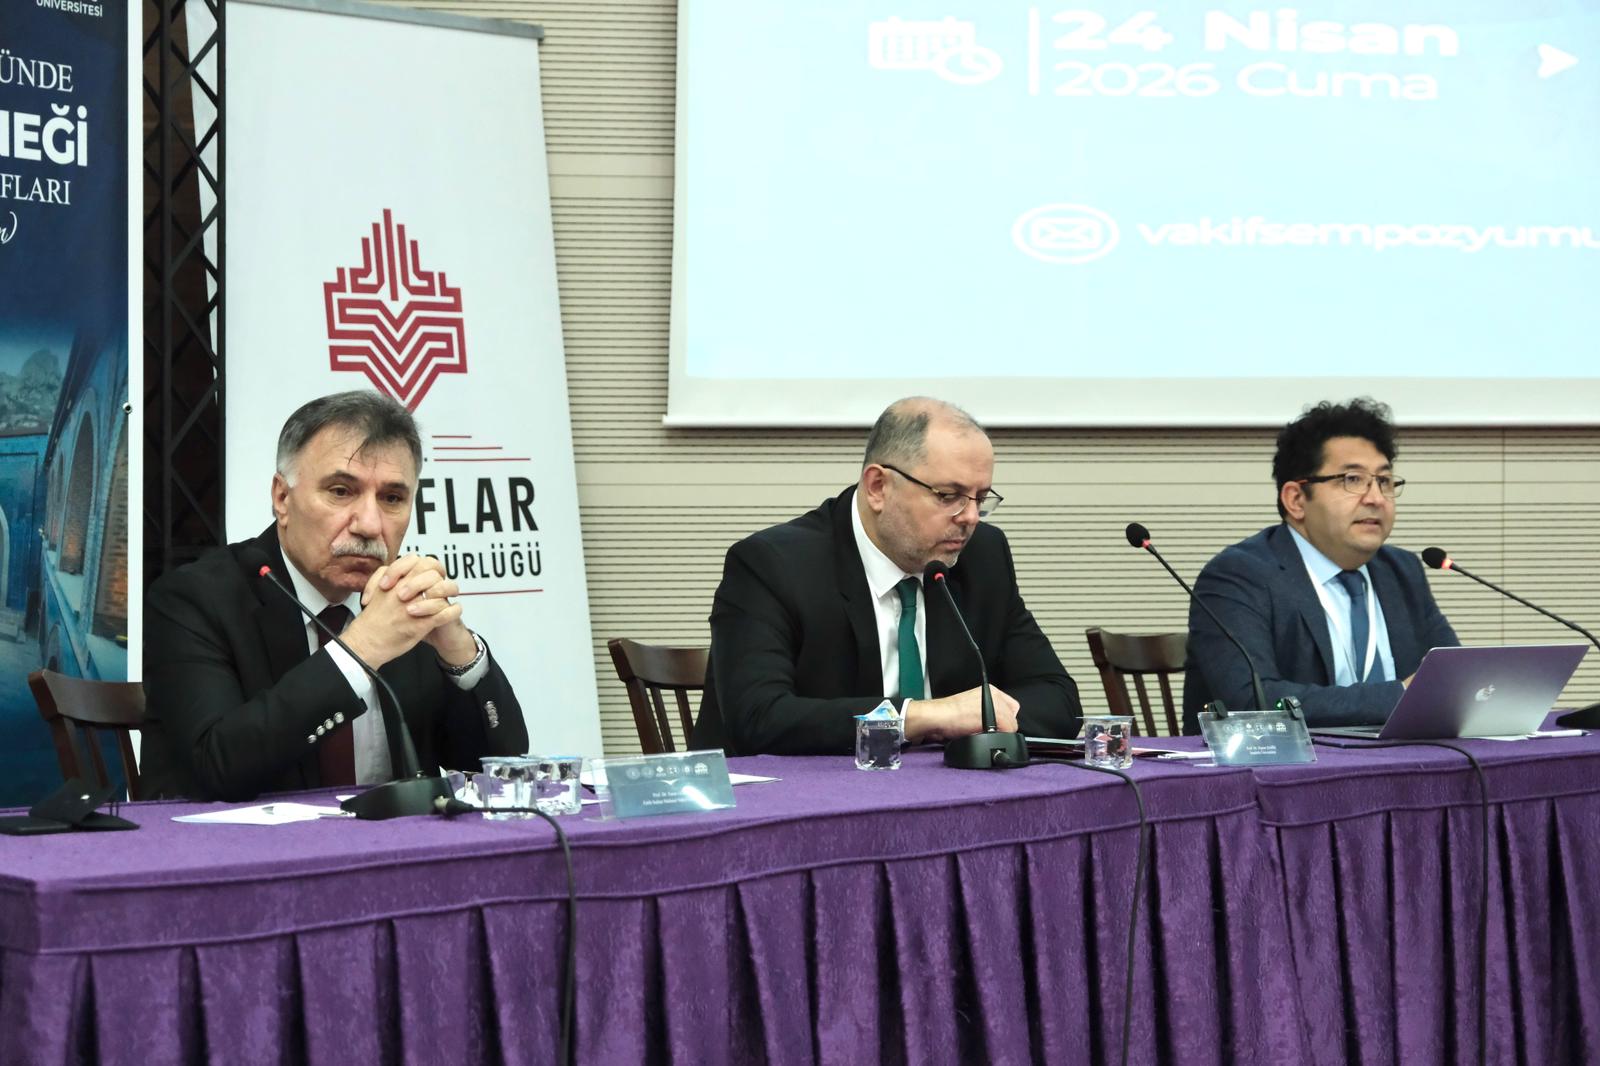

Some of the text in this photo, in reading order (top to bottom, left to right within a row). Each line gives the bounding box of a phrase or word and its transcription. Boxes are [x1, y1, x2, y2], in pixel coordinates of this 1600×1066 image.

[1052, 8, 1459, 56] 24 Nisan
[1054, 60, 1438, 100] 2026 Cuma
[397, 541, 542, 580] ÜRLÜĞÜ
